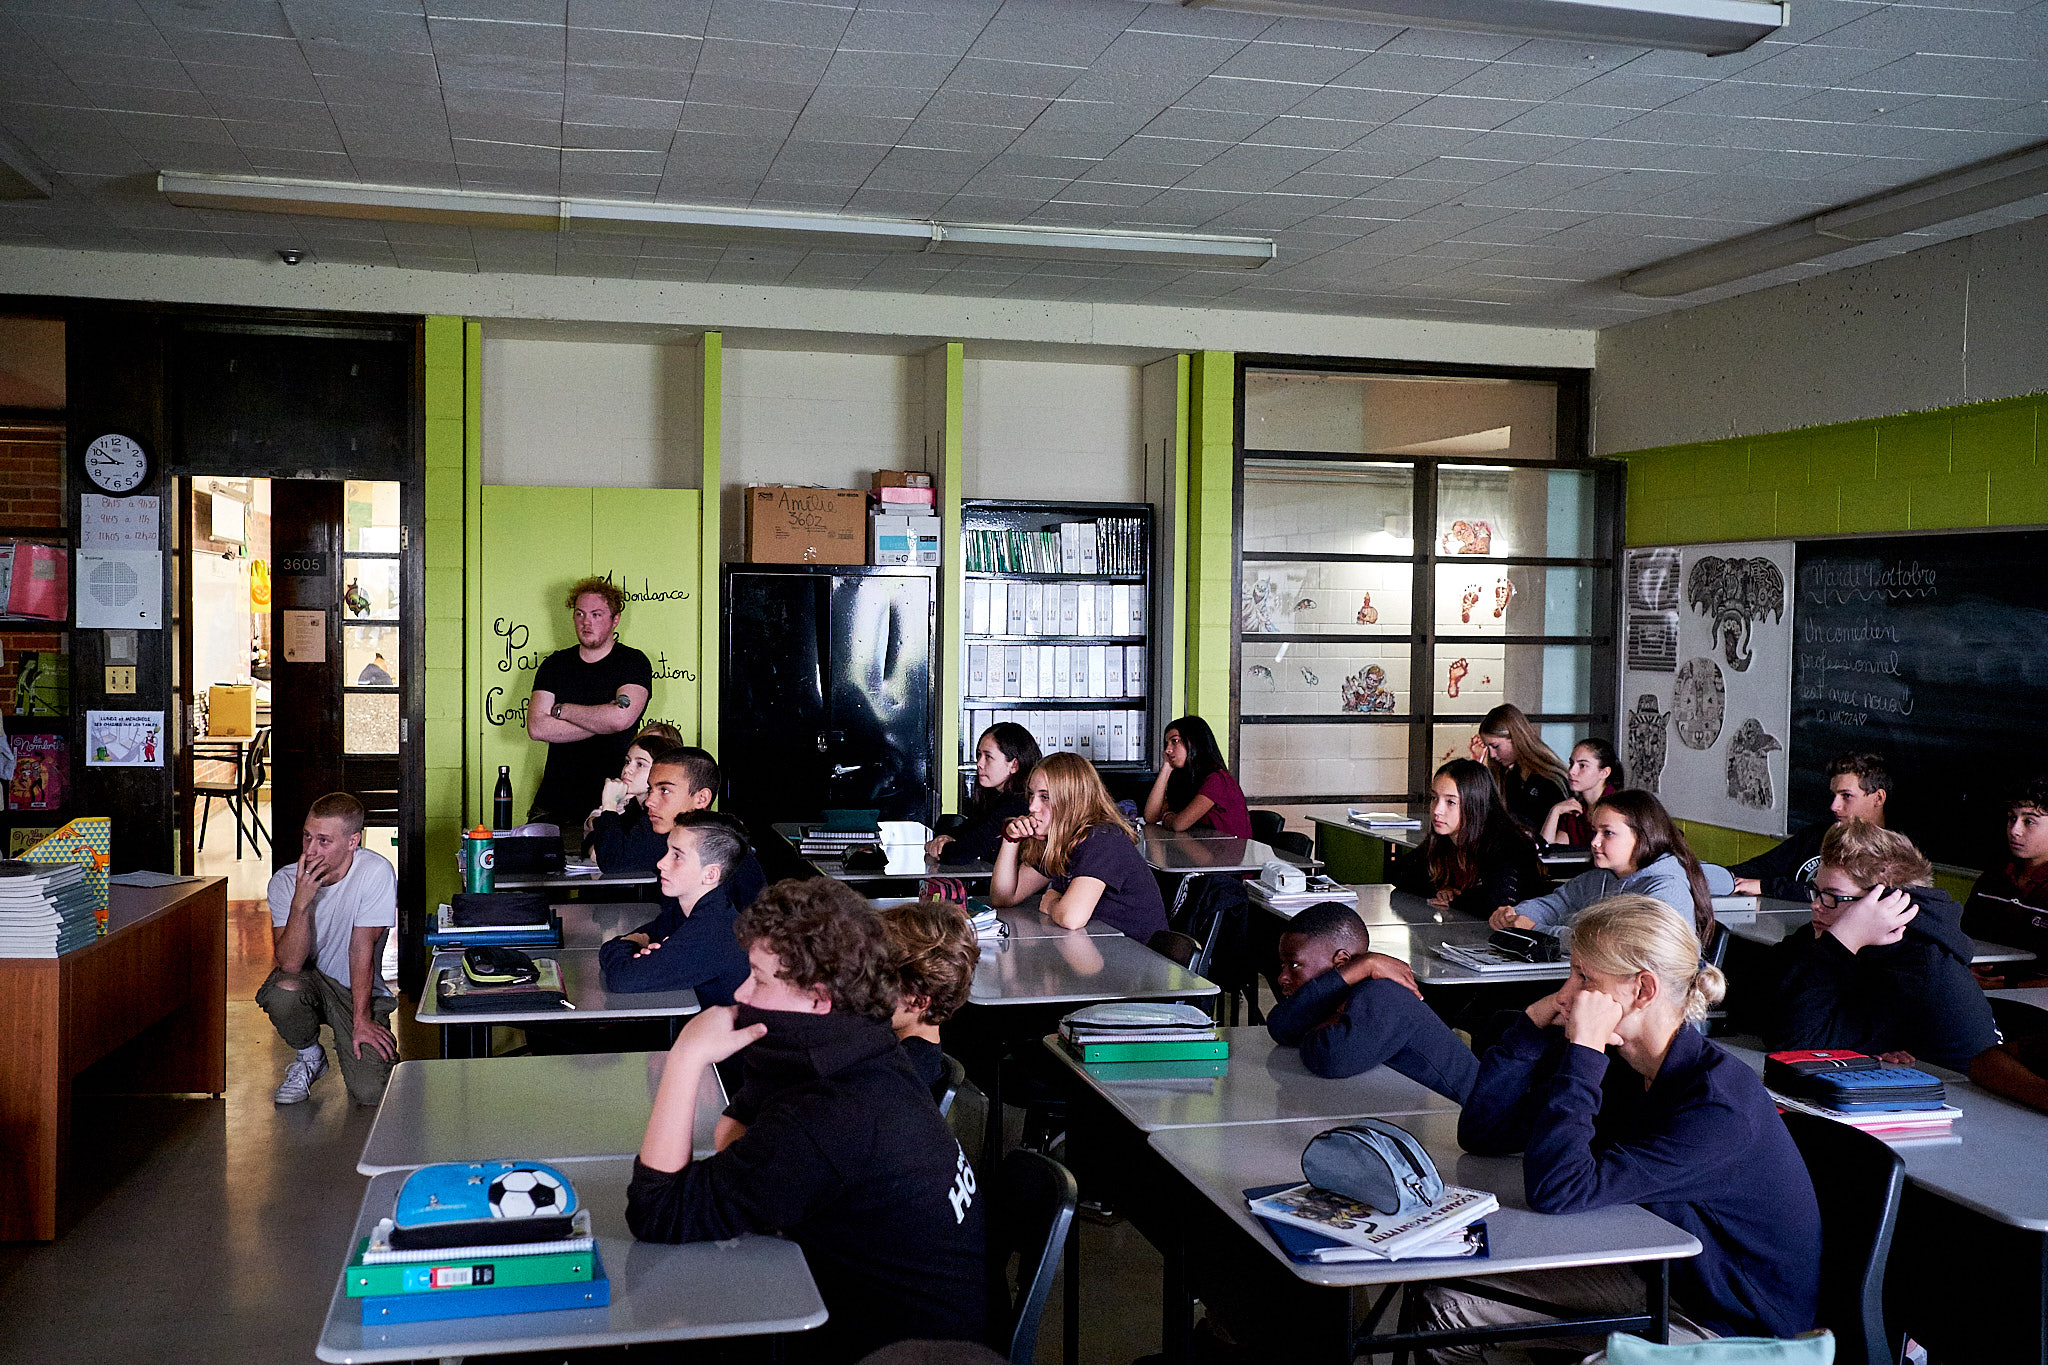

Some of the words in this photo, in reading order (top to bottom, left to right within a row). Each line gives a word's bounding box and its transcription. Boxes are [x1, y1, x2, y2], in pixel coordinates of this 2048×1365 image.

[111, 438, 121, 446] 12
[93, 448, 102, 456] 10
[90, 458, 98, 466] 9
[94, 469, 102, 477] 8
[84, 496, 91, 508] 1
[85, 514, 91, 524] 2
[788, 512, 826, 528] 3602
[283, 558, 320, 570] 3605
[1881, 560, 1936, 586] octobre
[1804, 616, 1824, 643] Un
[494, 618, 548, 672] Pai
[650, 652, 696, 681] ation
[479, 849, 495, 870] G
